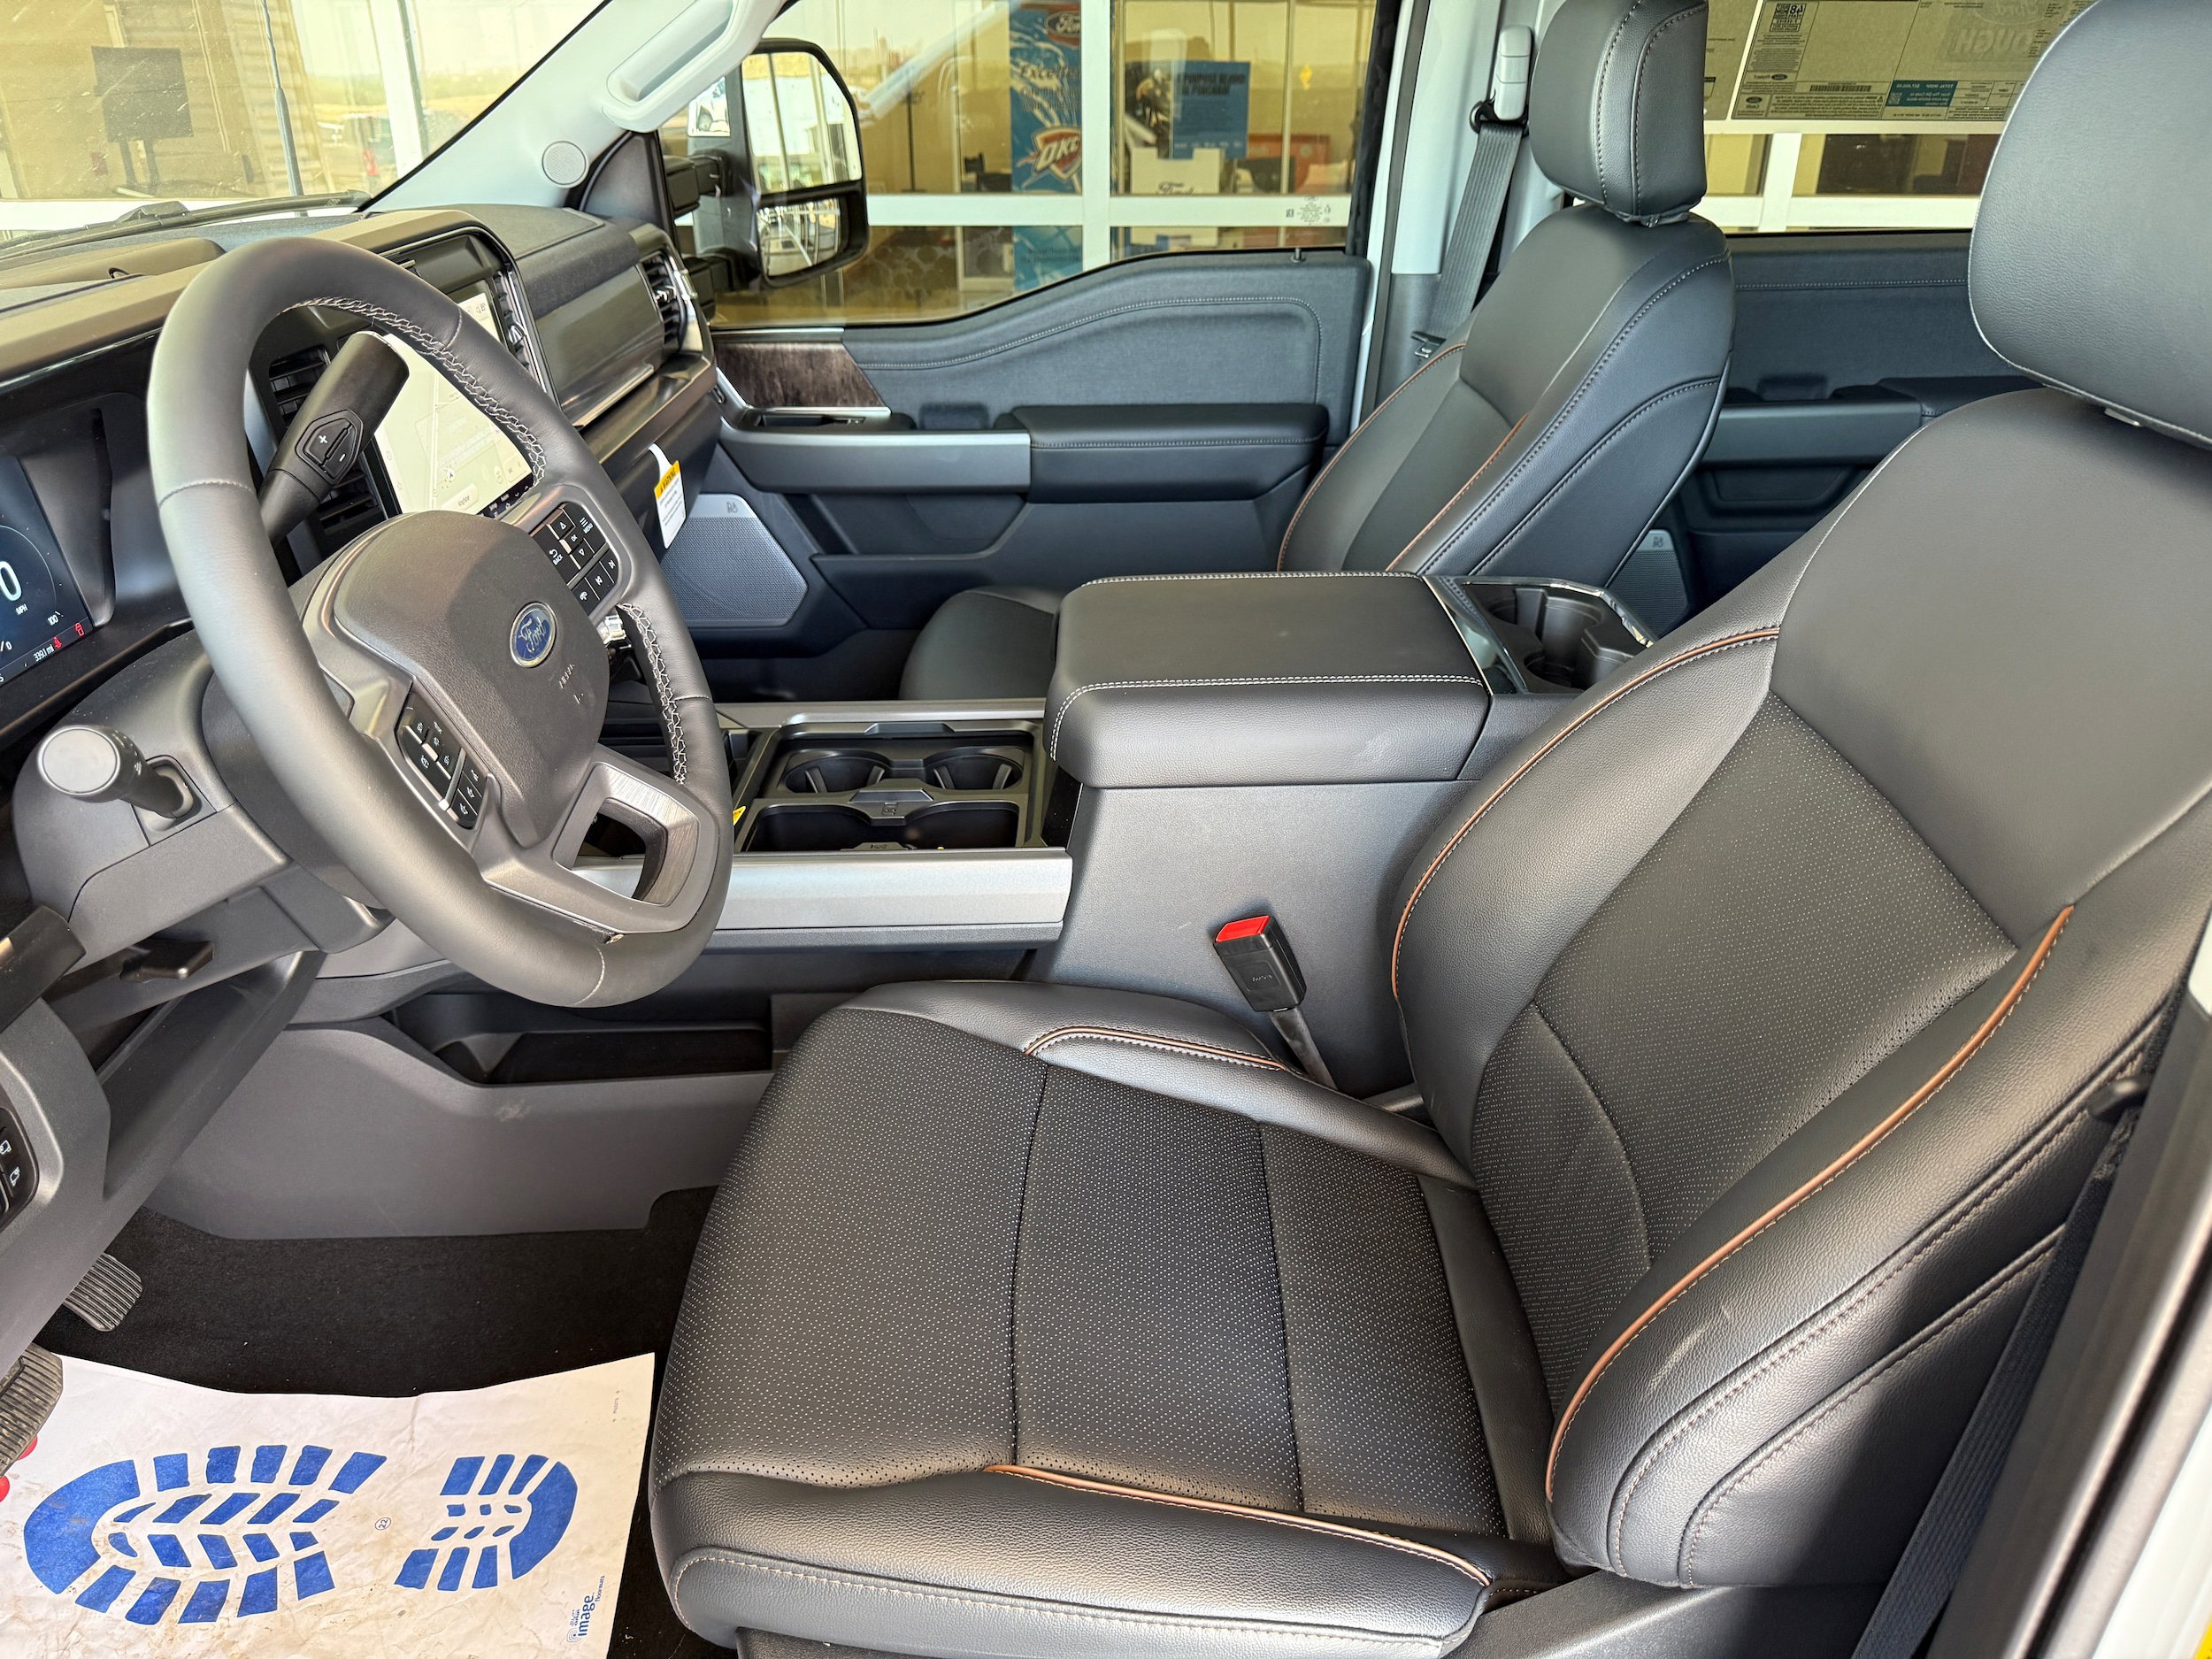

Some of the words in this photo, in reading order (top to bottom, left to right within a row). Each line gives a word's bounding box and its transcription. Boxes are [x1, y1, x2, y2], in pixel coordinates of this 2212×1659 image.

[1056, 12, 1080, 35] For
[1035, 136, 1080, 172] OKC
[583, 522, 594, 534] MENU
[552, 554, 564, 566] BACK
[16, 604, 28, 616] MPH
[48, 614, 58, 626] 100
[518, 617, 547, 654] Ford
[47, 643, 55, 656] mi
[378, 1518, 389, 1529] 22
[595, 1575, 605, 1602] floormats
[578, 1595, 595, 1636] image
